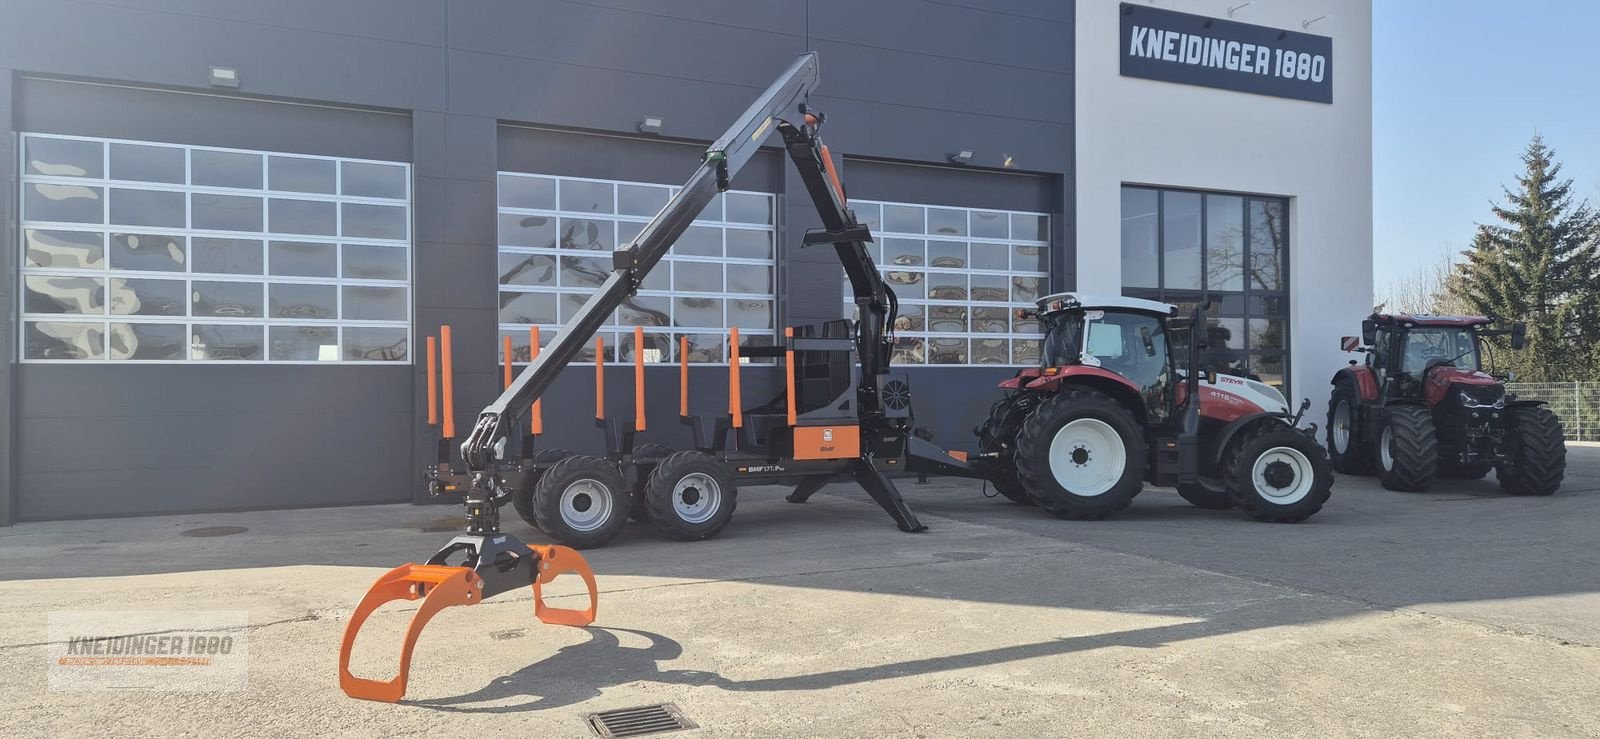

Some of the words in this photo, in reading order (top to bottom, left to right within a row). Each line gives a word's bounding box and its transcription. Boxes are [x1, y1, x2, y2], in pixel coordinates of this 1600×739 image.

[1130, 25, 1270, 76] KNEIDINGER
[1275, 49, 1326, 83] 1880
[1220, 376, 1244, 386] STEYR
